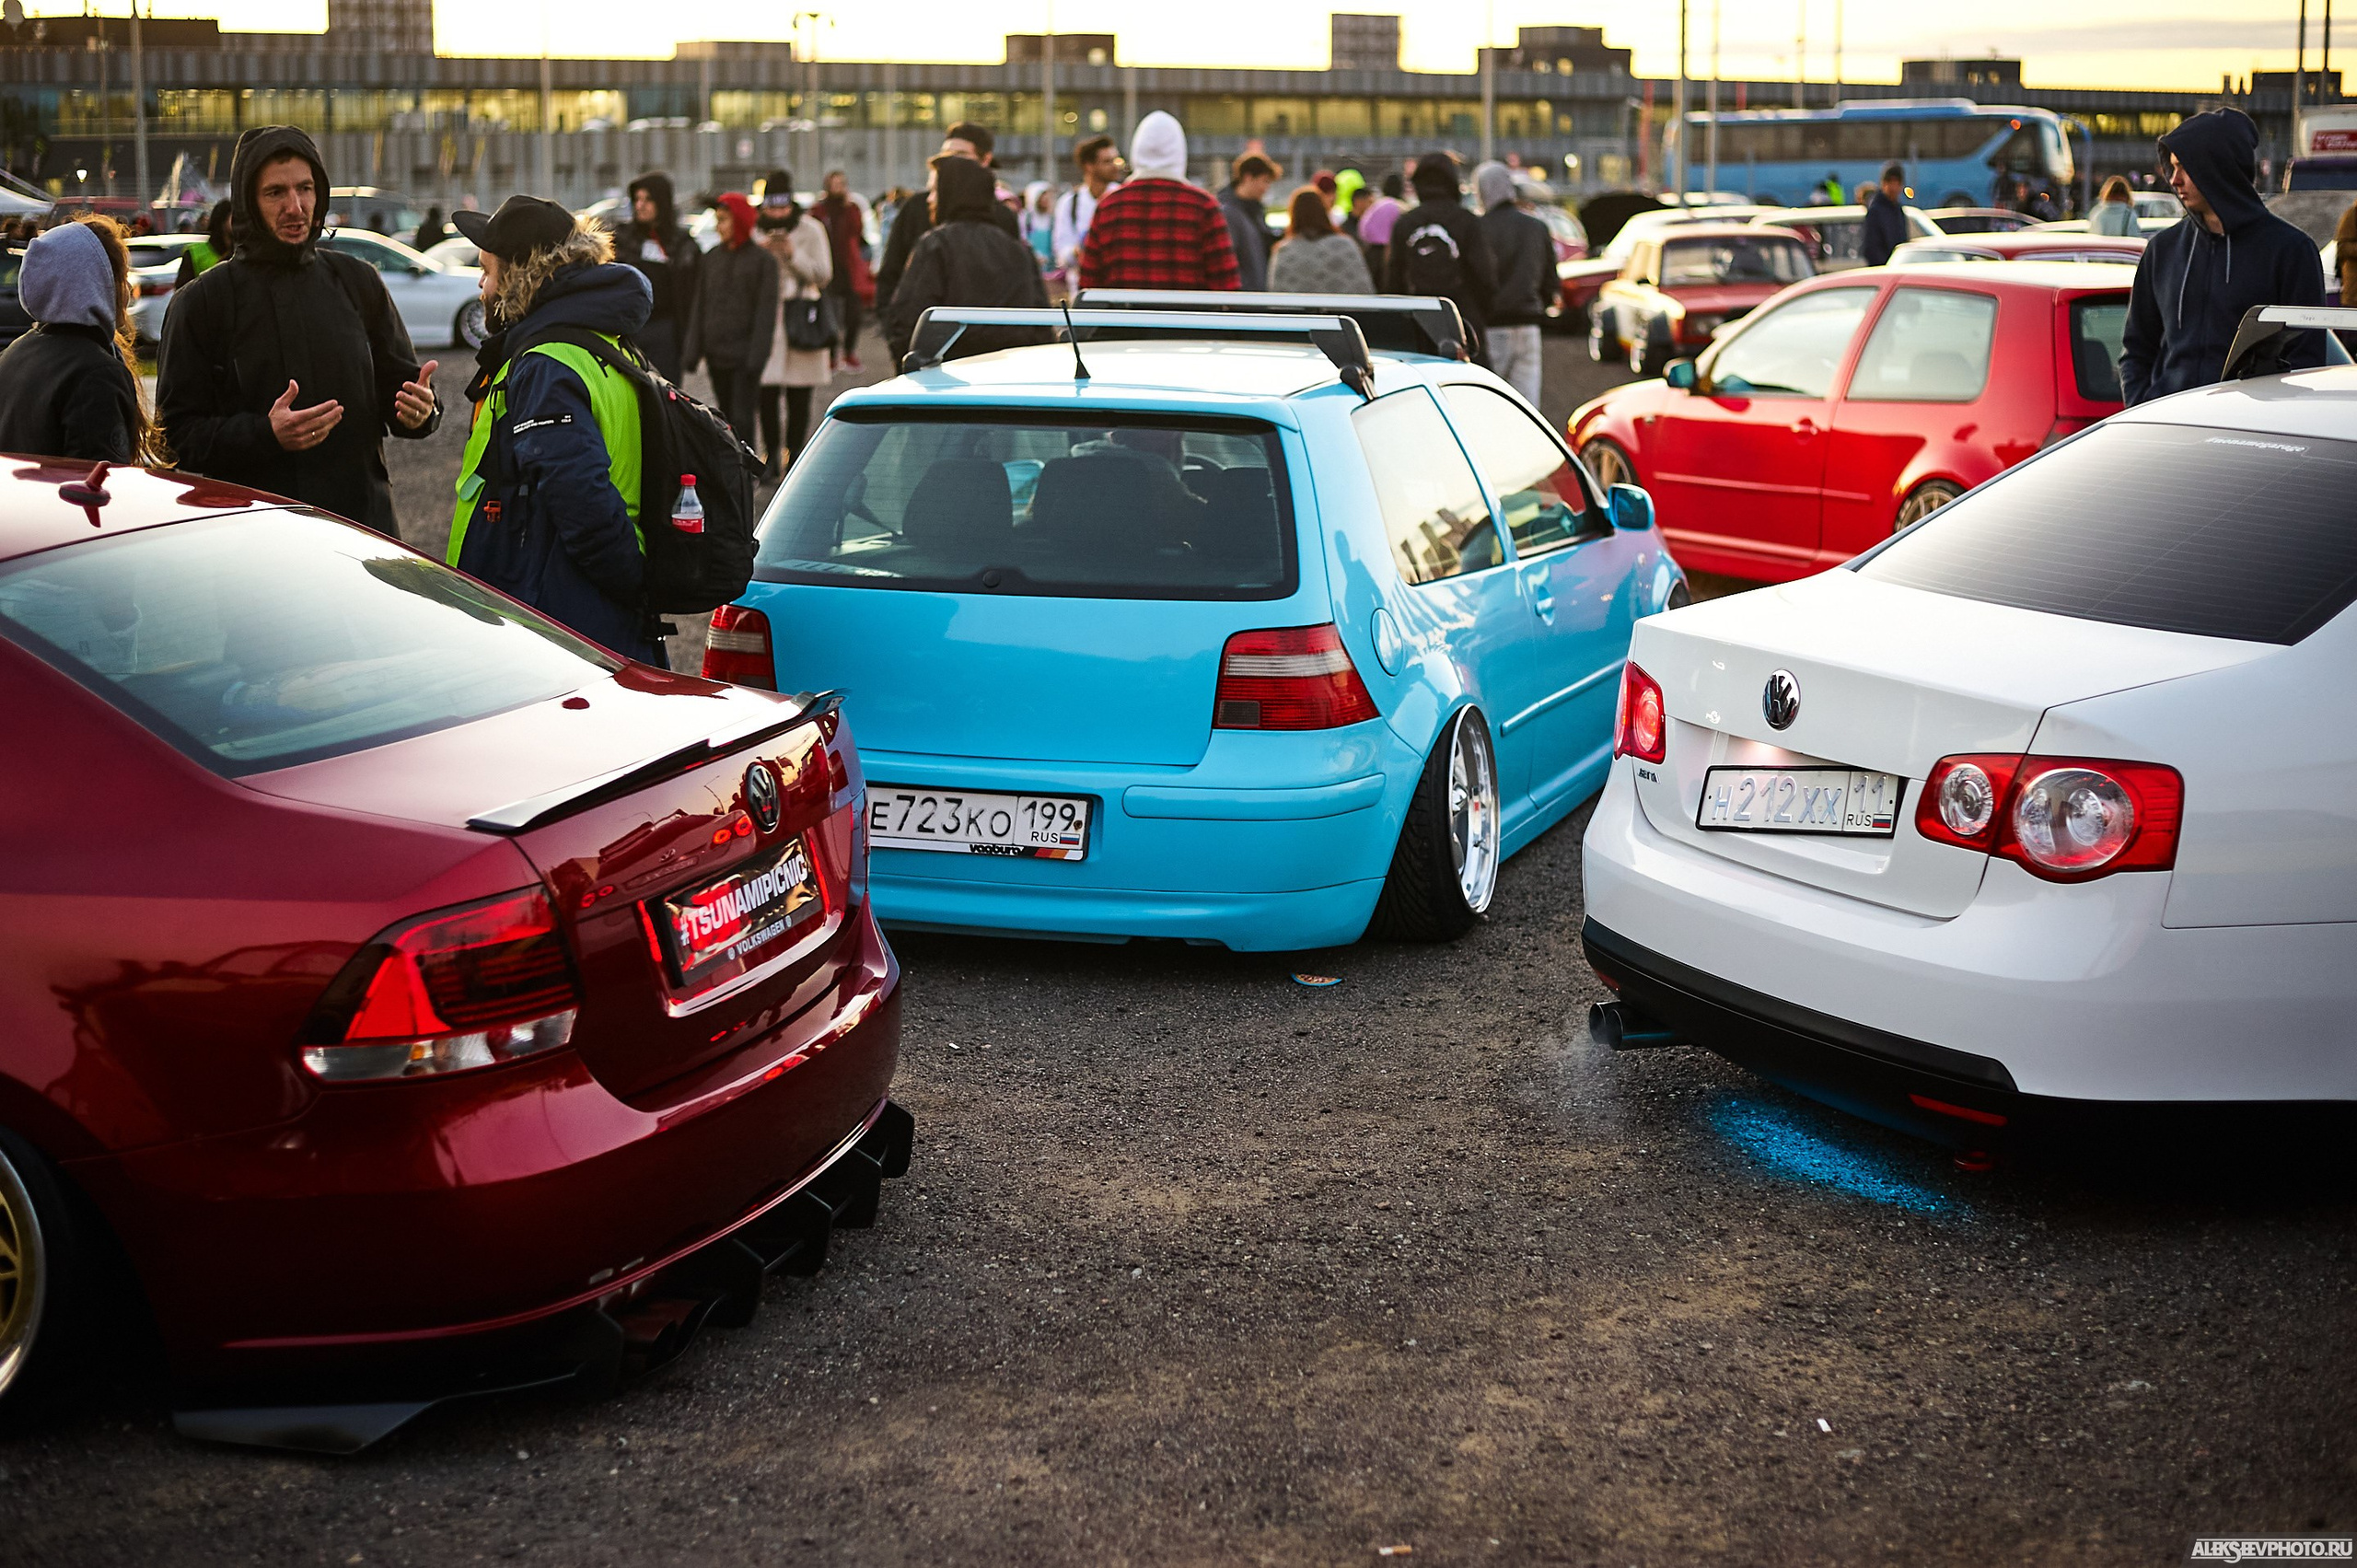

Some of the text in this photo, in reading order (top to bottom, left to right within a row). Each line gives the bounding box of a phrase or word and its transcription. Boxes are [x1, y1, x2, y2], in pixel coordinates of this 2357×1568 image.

[1854, 775, 1887, 813] 11
[1022, 801, 1076, 830] 199
[1846, 814, 1872, 827] RUS
[1031, 831, 1058, 843] RUS
[679, 854, 807, 947] #TSUNAMIPICNIC
[737, 919, 785, 955] VOLKSWAGEN
